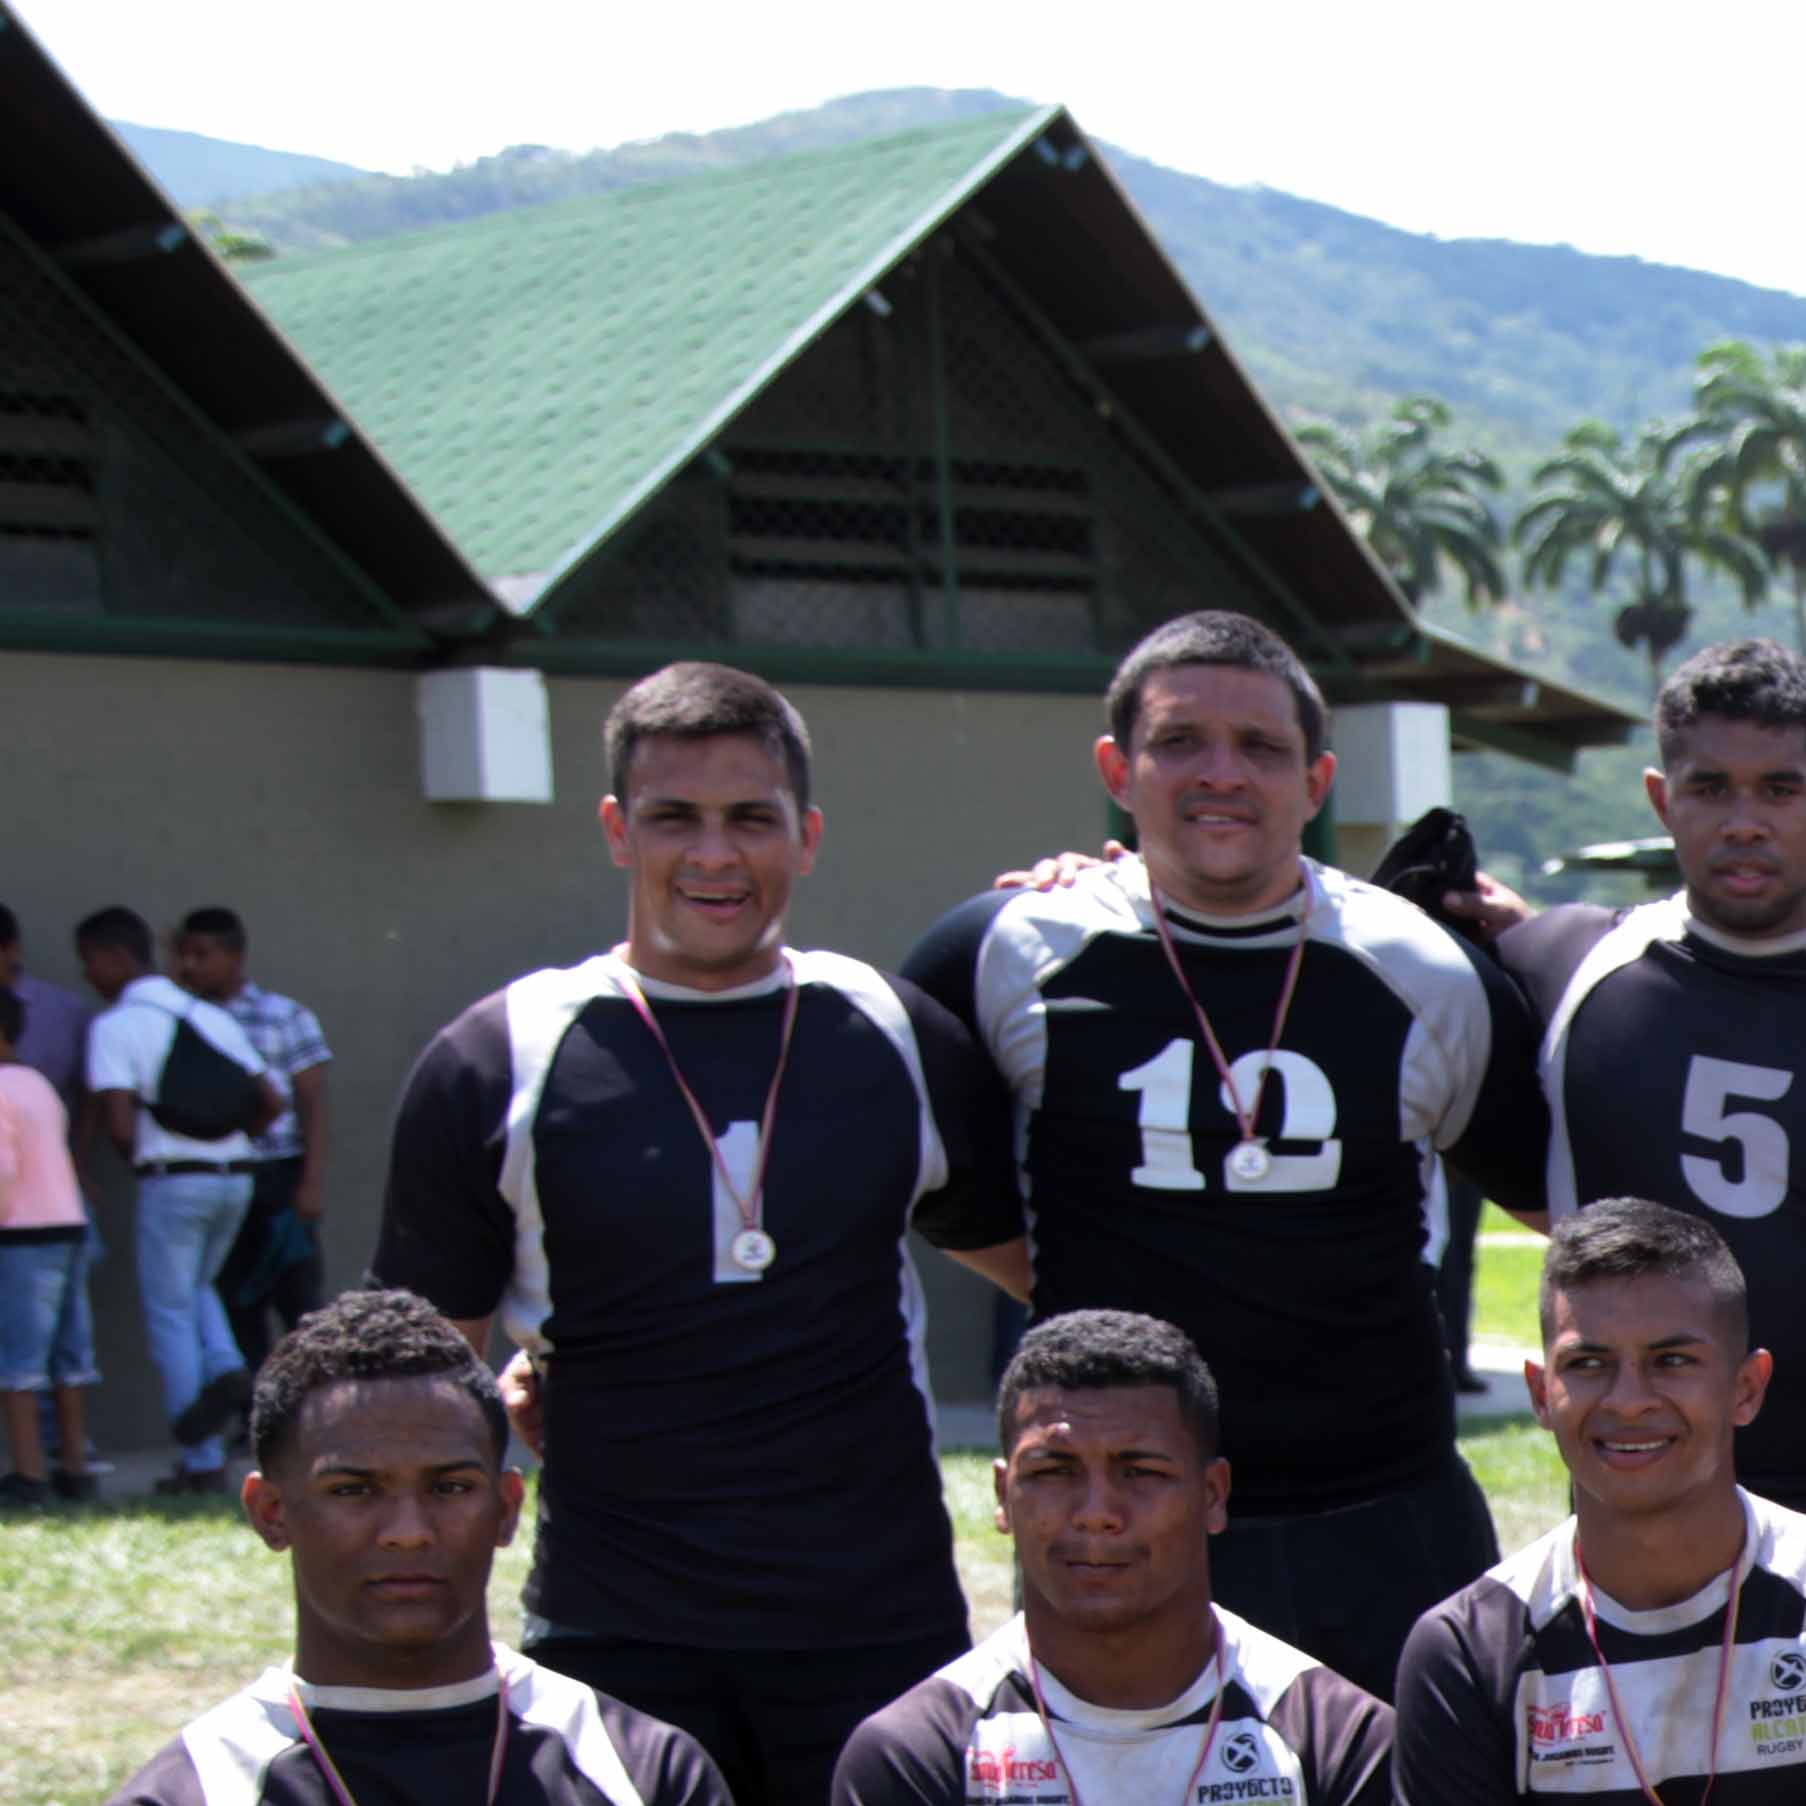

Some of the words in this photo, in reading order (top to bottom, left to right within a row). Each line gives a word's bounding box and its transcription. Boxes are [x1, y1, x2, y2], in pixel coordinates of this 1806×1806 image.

[1118, 1037, 1342, 1192] 12
[1681, 1054, 1793, 1219] 5
[712, 1119, 763, 1283] 1
[1197, 1777, 1293, 1804] PROYECTO
[1757, 1738, 1803, 1756] RUGBY
